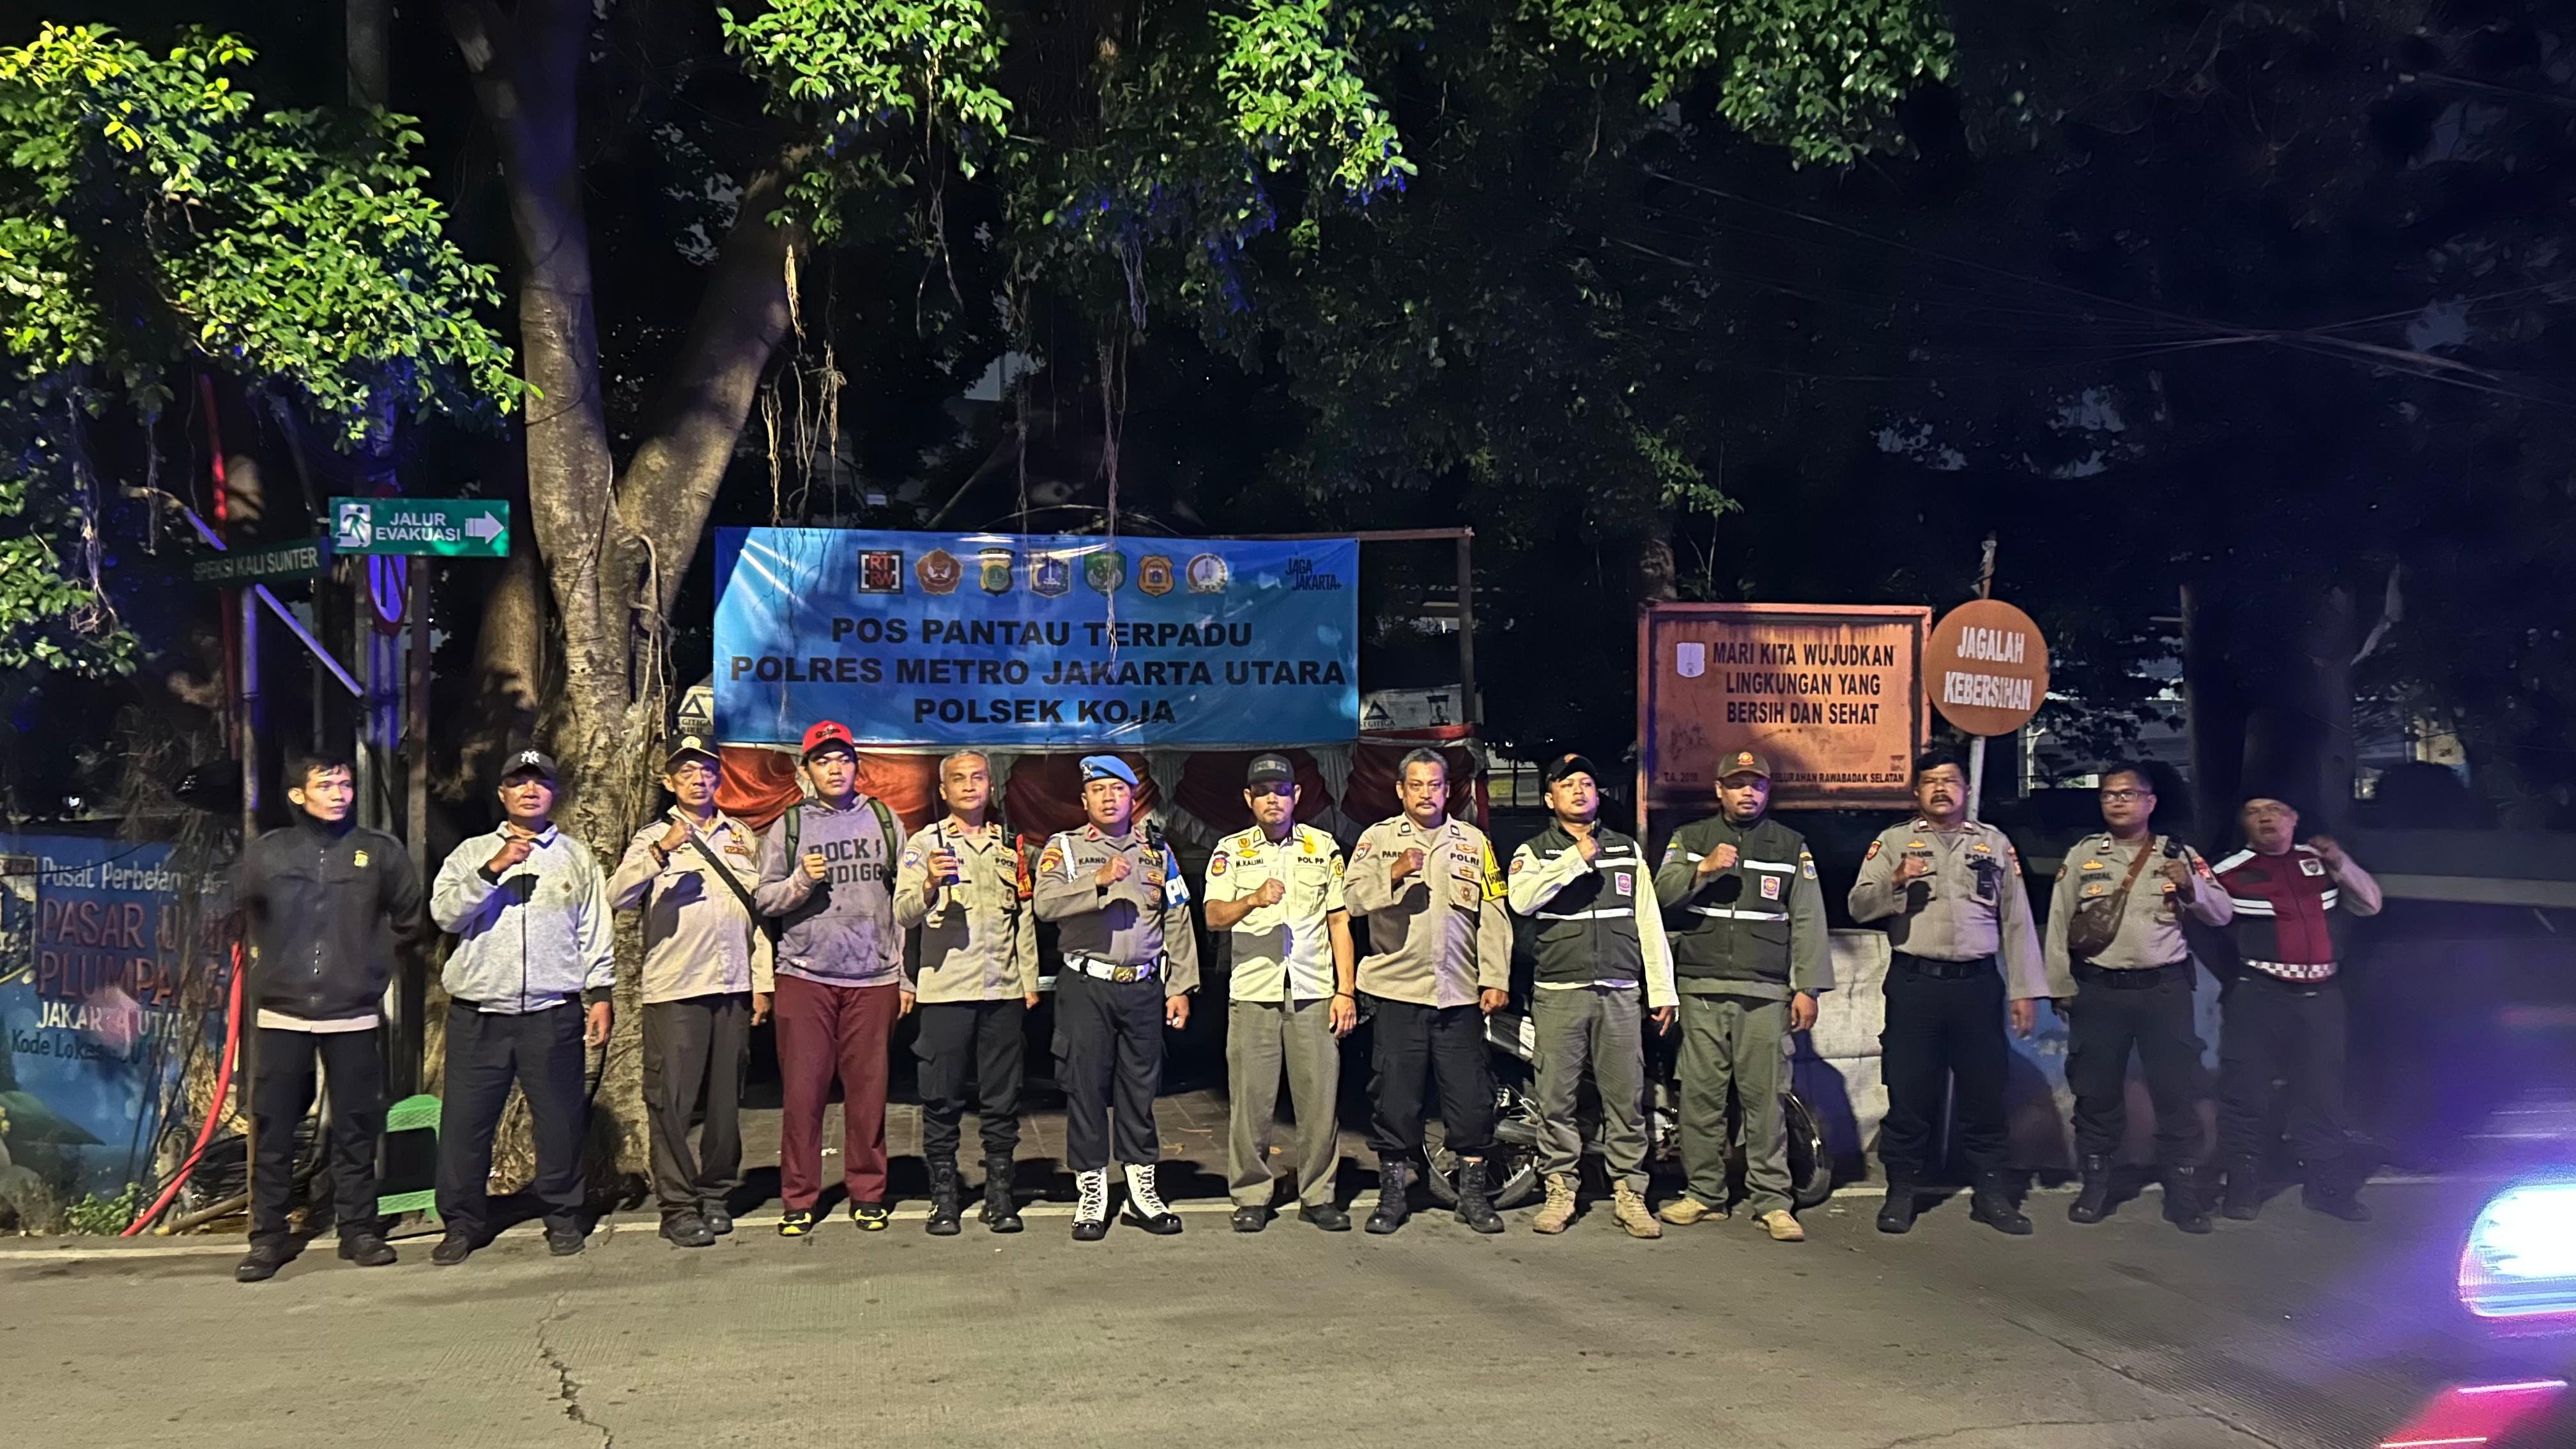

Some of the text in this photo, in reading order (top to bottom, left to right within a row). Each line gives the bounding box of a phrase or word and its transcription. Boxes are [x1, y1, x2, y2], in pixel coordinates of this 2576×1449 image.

[390, 512, 447, 526] JALUR
[376, 527, 461, 541] EVAKUASI
[236, 553, 265, 576] KALI
[266, 547, 319, 573] SUNTER
[870, 555, 889, 570] RT
[1285, 553, 1313, 575] JAGA
[870, 571, 893, 586] RW
[832, 617, 1252, 647] POS PANTAU TERPADU
[1713, 642, 1894, 666] MARI KITA WUJUDKAN
[1957, 625, 2025, 664] JAGALAH
[731, 656, 1347, 686] POLRES METRO JAKARTA UTARA
[1726, 672, 1881, 696] LINGKUNGAN YANG
[1943, 671, 2033, 711] KEBERSIHAN
[680, 718, 712, 727] GITIGA
[914, 698, 1176, 724] POLSEK KOJA
[1727, 702, 1880, 724] BERSIH DAN SEHAT
[1819, 772, 1868, 783] RAWABADAK
[1870, 772, 1905, 783] SELATAN
[1078, 857, 1107, 865] KARNO
[1450, 852, 1480, 866] POLRI
[42, 856, 95, 888] Pusat
[39, 898, 146, 949] PASAR
[37, 950, 225, 1011] PLUMPAG
[12, 1029, 50, 1055] Kode
